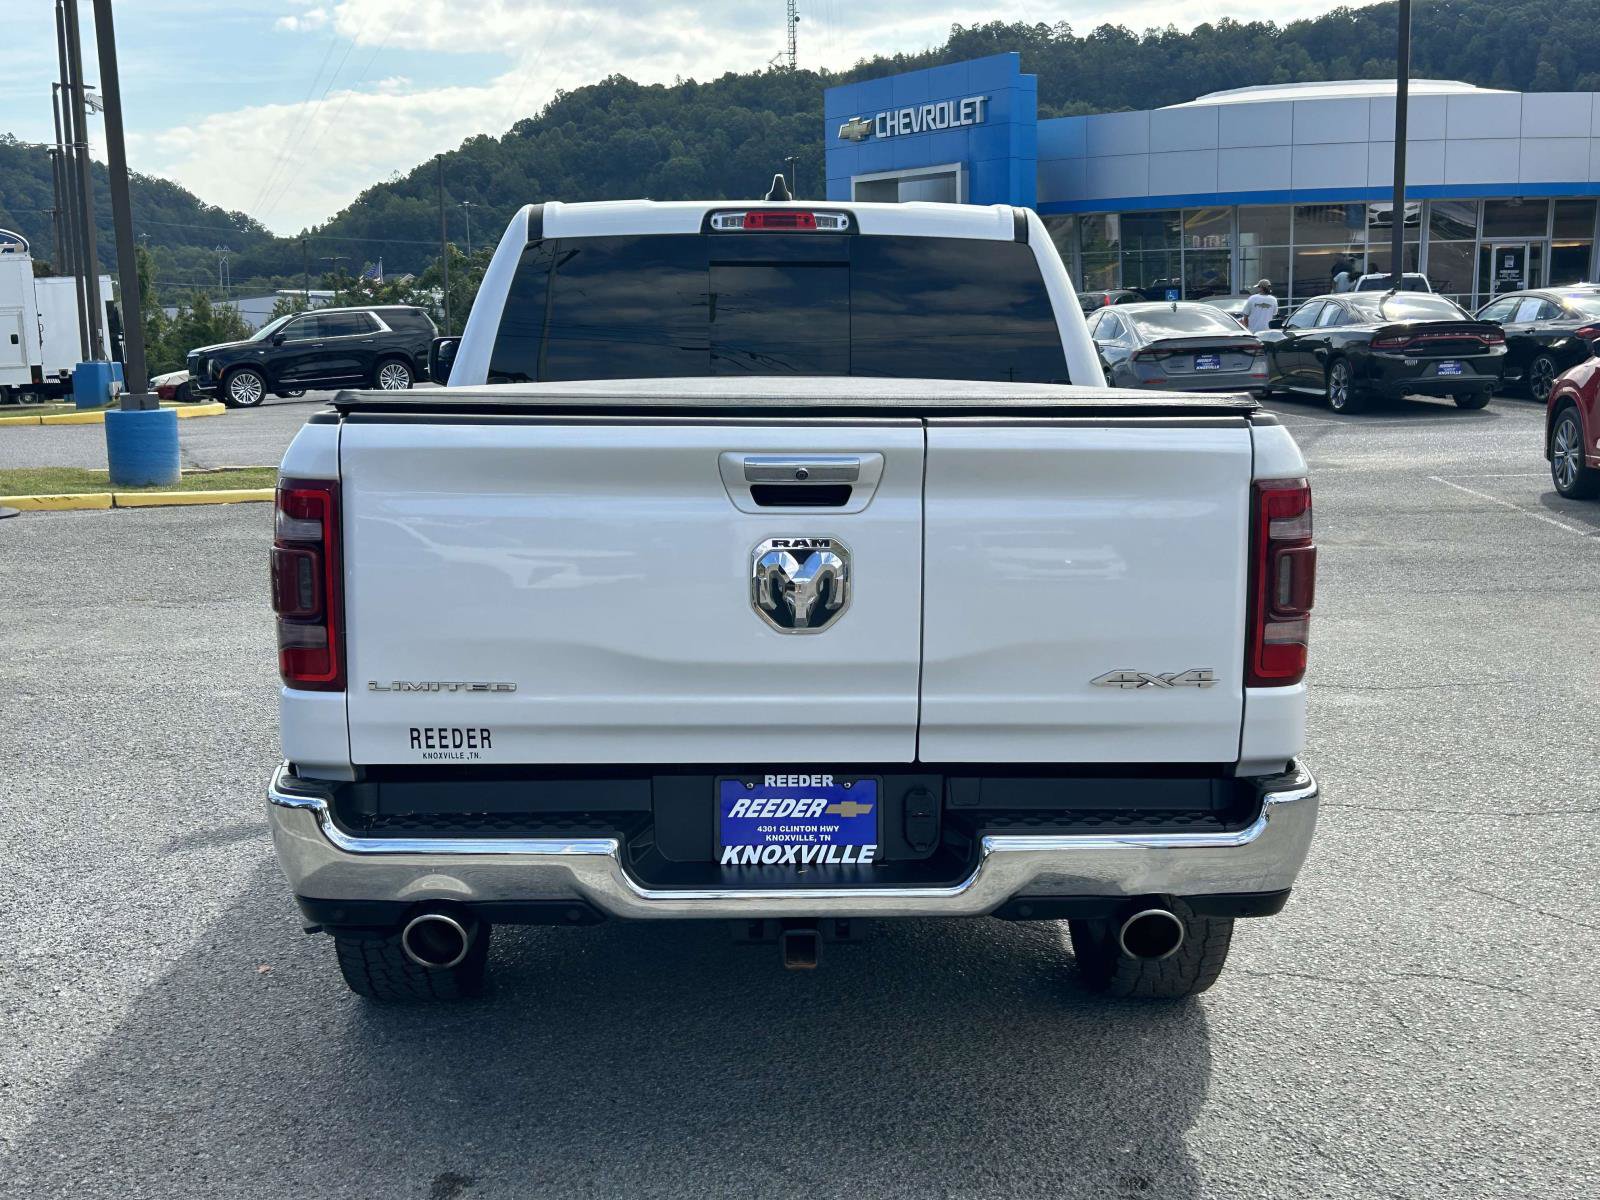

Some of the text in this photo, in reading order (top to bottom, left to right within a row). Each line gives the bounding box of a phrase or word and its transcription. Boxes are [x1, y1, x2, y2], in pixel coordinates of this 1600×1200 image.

[875, 96, 987, 138] CHEVROLET
[771, 539, 831, 548] RAM
[368, 680, 518, 692] LIMITED
[409, 727, 493, 750] REEDER
[764, 774, 834, 788] REEDER
[727, 798, 828, 818] REEDER
[765, 834, 817, 842] KNOXVILLE,
[720, 844, 878, 865] KNOXVILLE
